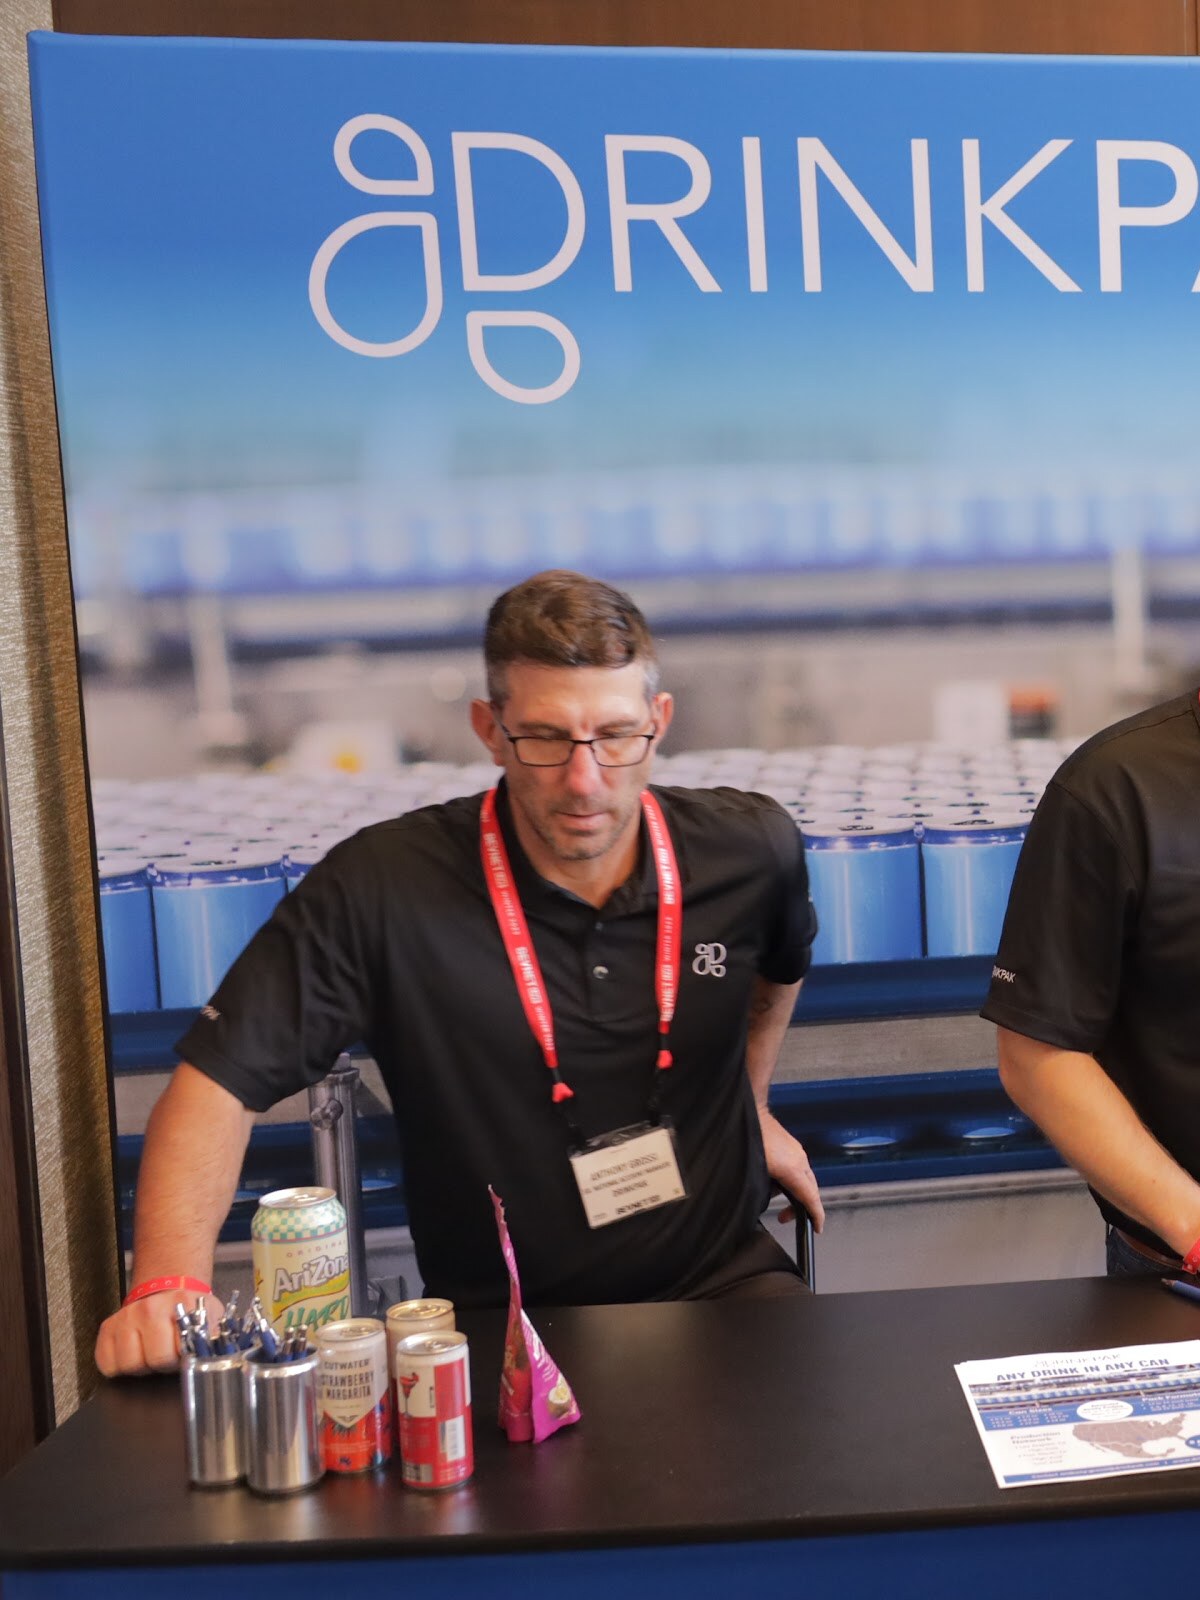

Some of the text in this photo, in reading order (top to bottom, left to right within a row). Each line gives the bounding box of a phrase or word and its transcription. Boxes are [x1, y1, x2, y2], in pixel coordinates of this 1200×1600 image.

[286, 1240, 345, 1258] ORIGINA
[324, 1358, 370, 1370] CUTWATER
[996, 1358, 1170, 1382] ANY DRINK IN ANY CAN
[327, 1385, 371, 1401] MARGARITA
